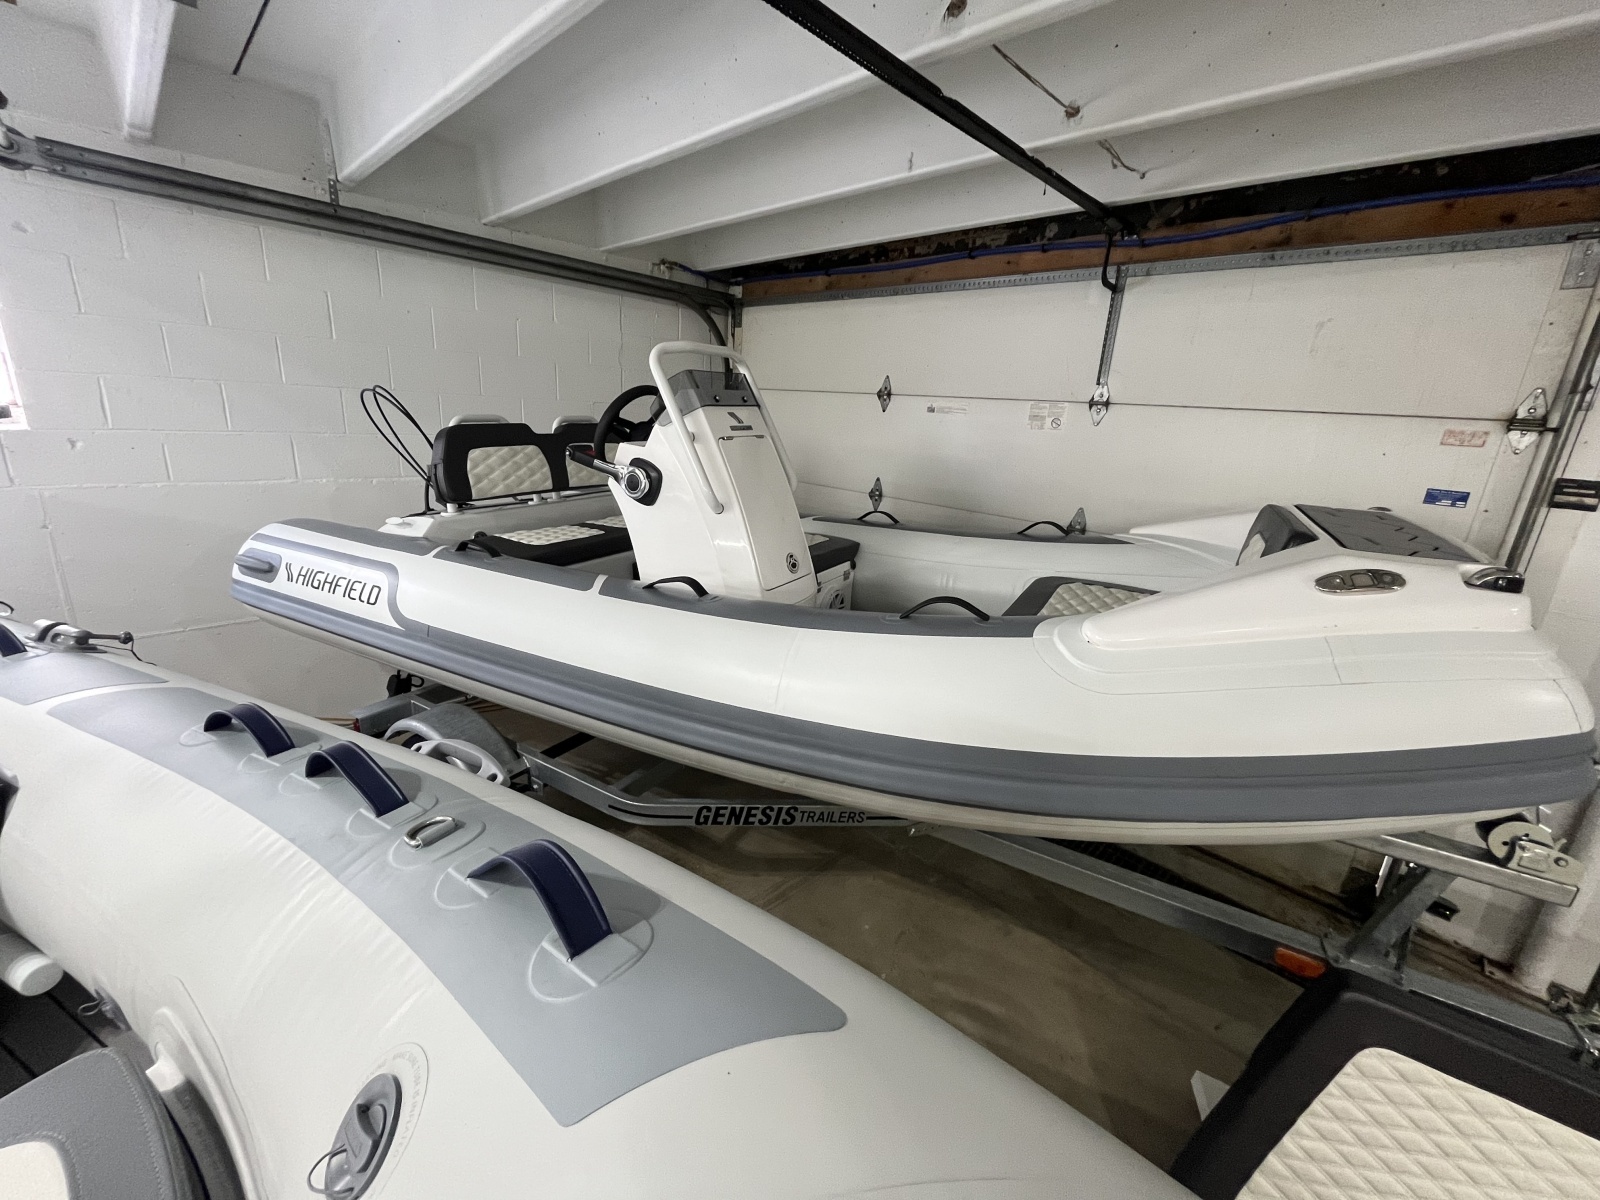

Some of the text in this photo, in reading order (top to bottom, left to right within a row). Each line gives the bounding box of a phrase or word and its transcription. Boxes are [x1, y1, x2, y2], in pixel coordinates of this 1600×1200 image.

[295, 566, 382, 606] HIGHFIELD
[694, 805, 866, 826] GENESIS TRAILERS
